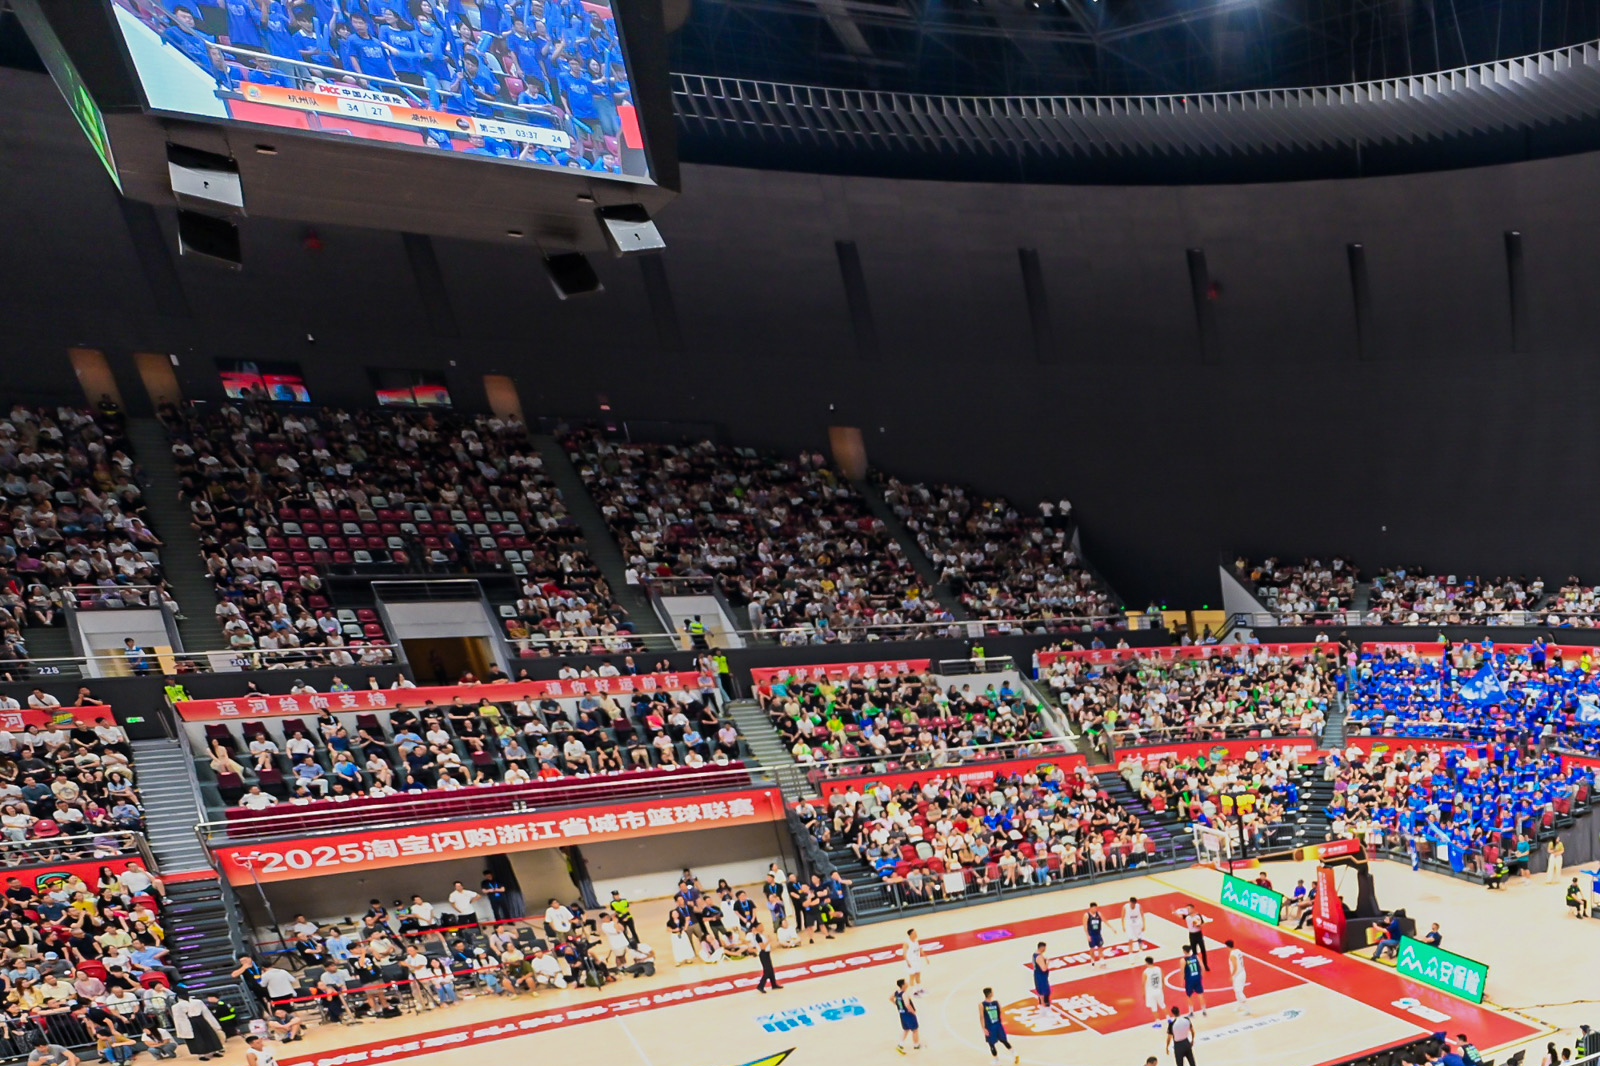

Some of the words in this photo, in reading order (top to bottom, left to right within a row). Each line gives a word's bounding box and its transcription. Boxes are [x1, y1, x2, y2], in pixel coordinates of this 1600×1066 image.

[287, 94, 320, 107] 杭州队
[342, 88, 403, 105] 中国人民保险
[346, 103, 359, 113] 34
[371, 107, 383, 117] 27
[479, 123, 506, 135] 第二节
[515, 129, 538, 140] 03:37
[551, 134, 562, 143] 24
[230, 658, 251, 667] 201
[37, 665, 60, 676] 228
[216, 690, 388, 717] 运河给你支持
[545, 674, 679, 696] 请你好运前行
[258, 797, 755, 875] 2025淘宝闪购浙江省城市篮球联赛
